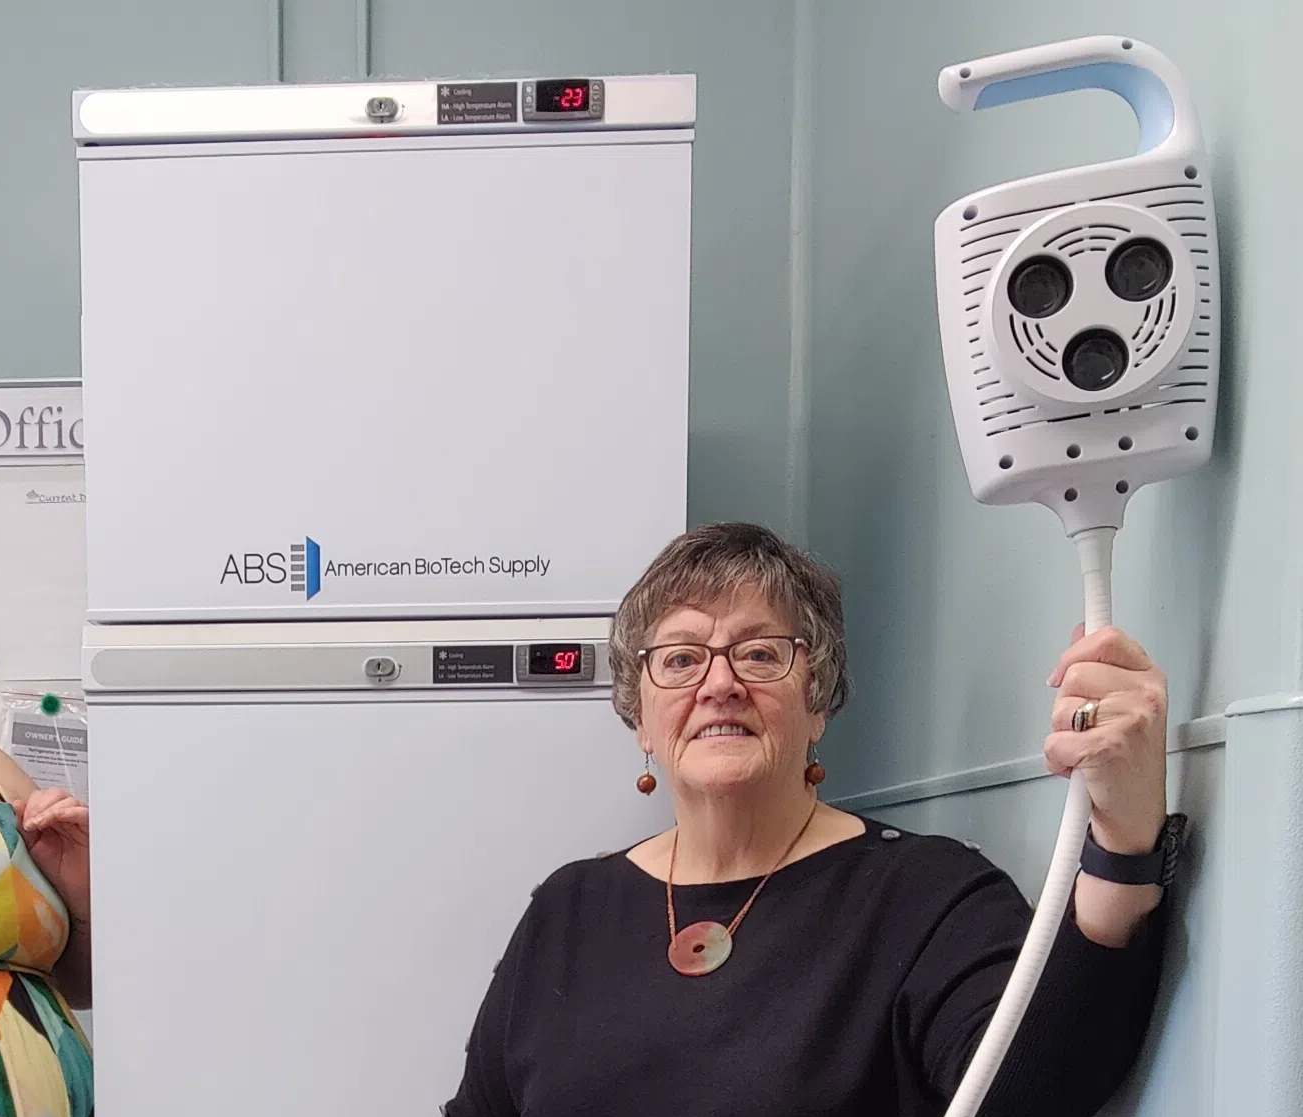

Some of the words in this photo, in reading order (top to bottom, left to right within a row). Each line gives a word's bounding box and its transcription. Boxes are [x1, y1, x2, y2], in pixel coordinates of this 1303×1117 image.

[220, 553, 287, 584] ABS
[324, 559, 411, 577] American
[415, 556, 485, 575] BioTech
[488, 555, 551, 577] Supply
[25, 731, 59, 742] OWNER'
[60, 735, 84, 745] GUIDE
